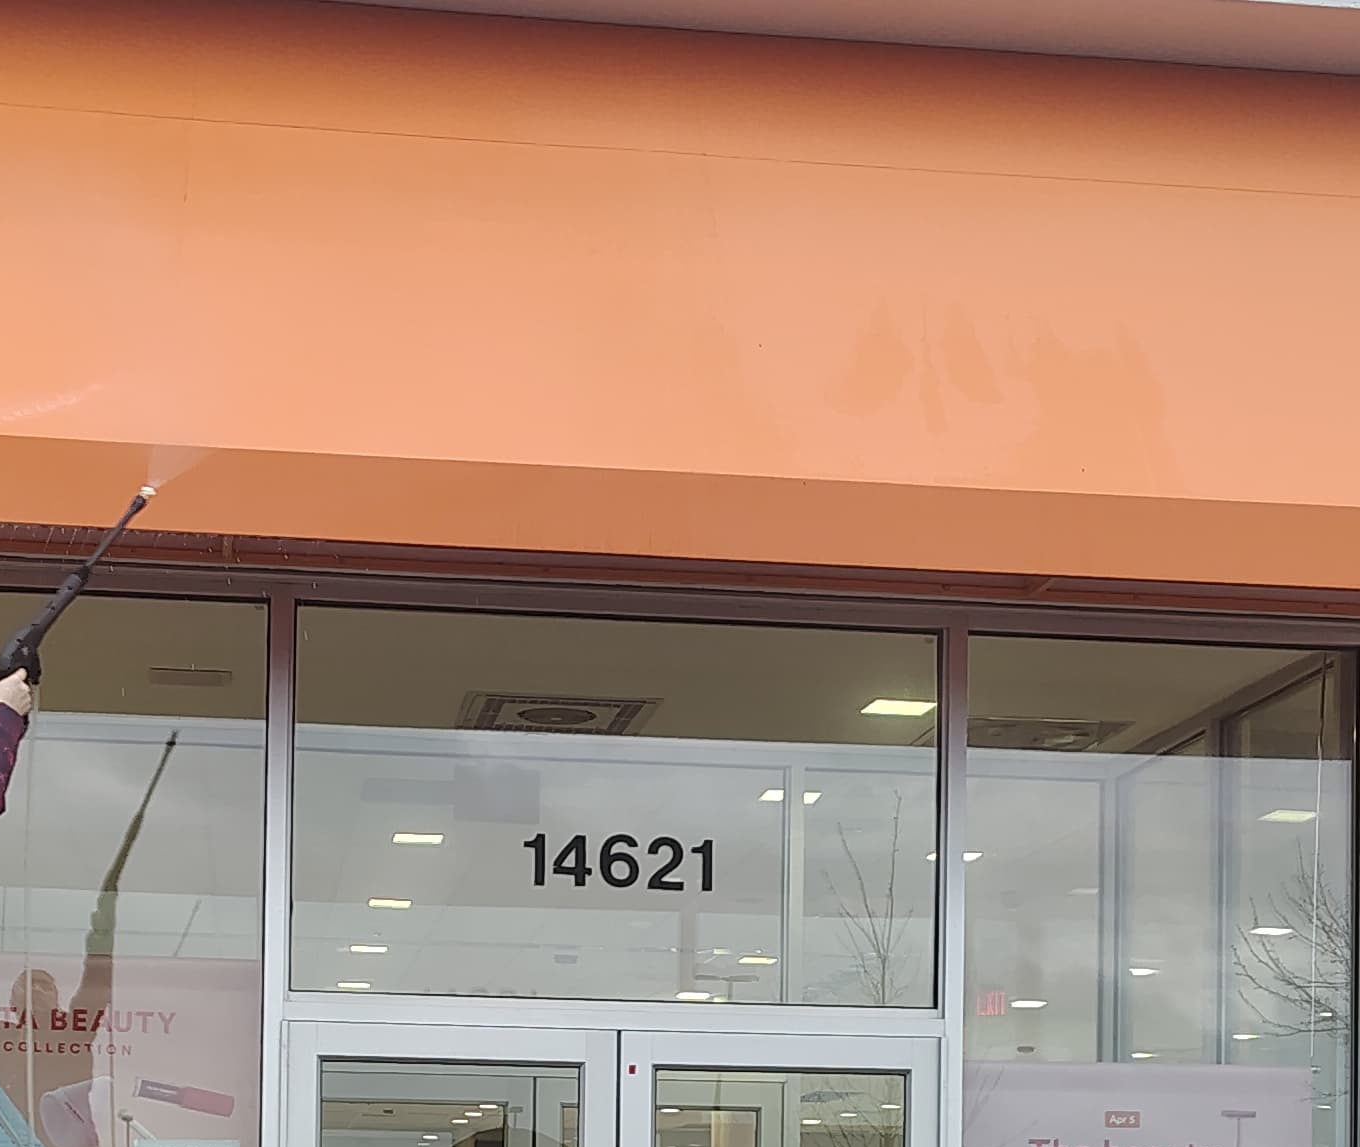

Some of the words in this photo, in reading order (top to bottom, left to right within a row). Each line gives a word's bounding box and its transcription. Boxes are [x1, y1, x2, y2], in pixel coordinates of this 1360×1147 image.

[523, 833, 713, 892] 14621
[50, 1007, 177, 1035] BEAUTY
[2, 1040, 133, 1056] COLLECTION
